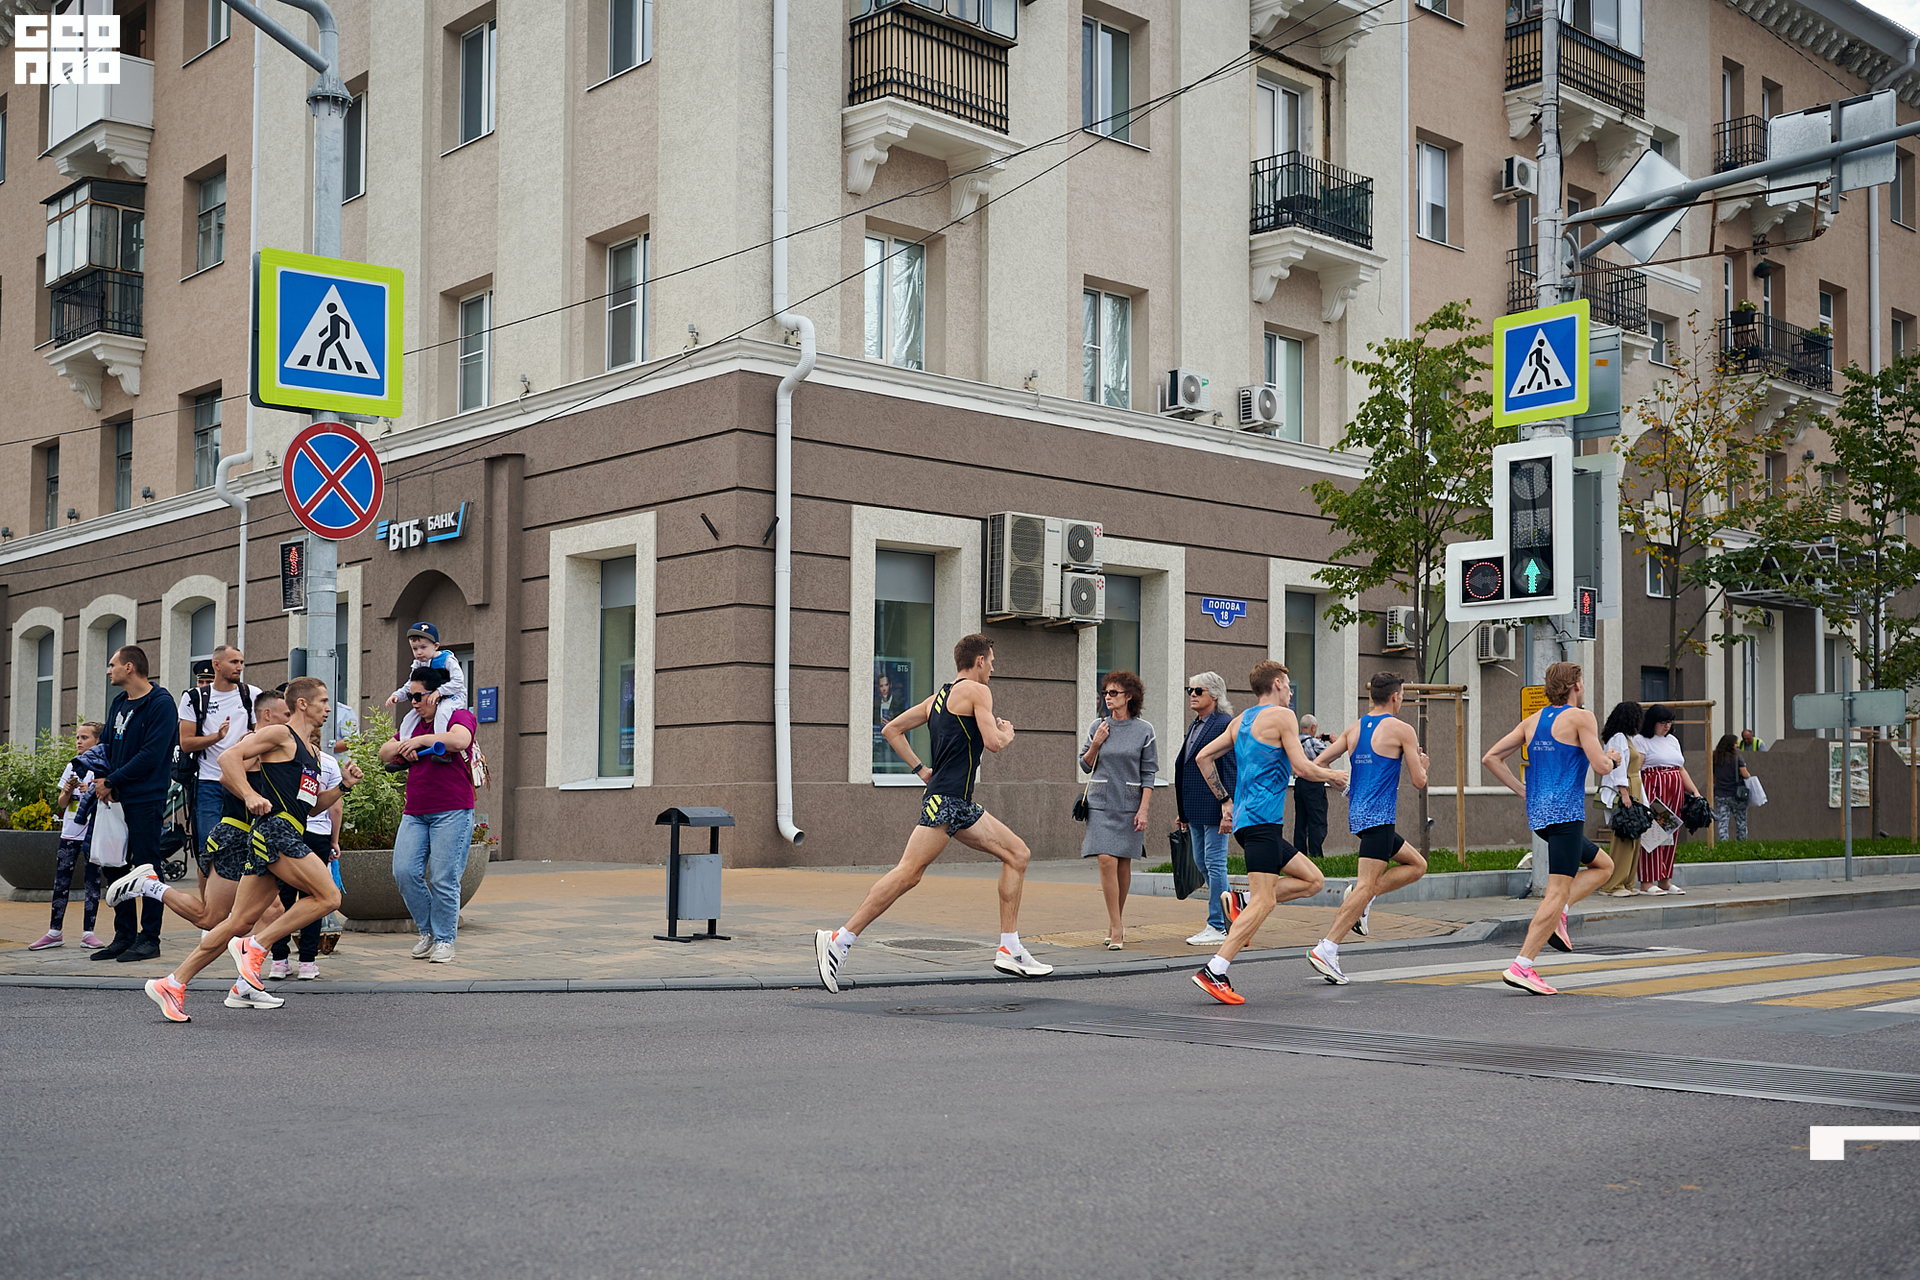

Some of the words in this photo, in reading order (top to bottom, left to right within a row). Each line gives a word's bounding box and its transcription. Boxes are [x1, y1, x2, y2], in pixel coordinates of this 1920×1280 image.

[389, 519, 423, 551] ВТБ
[428, 512, 458, 531] БАНК
[1209, 600, 1240, 611] ПОПОВА
[1220, 611, 1229, 620] 18
[897, 664, 909, 672] ВТБ
